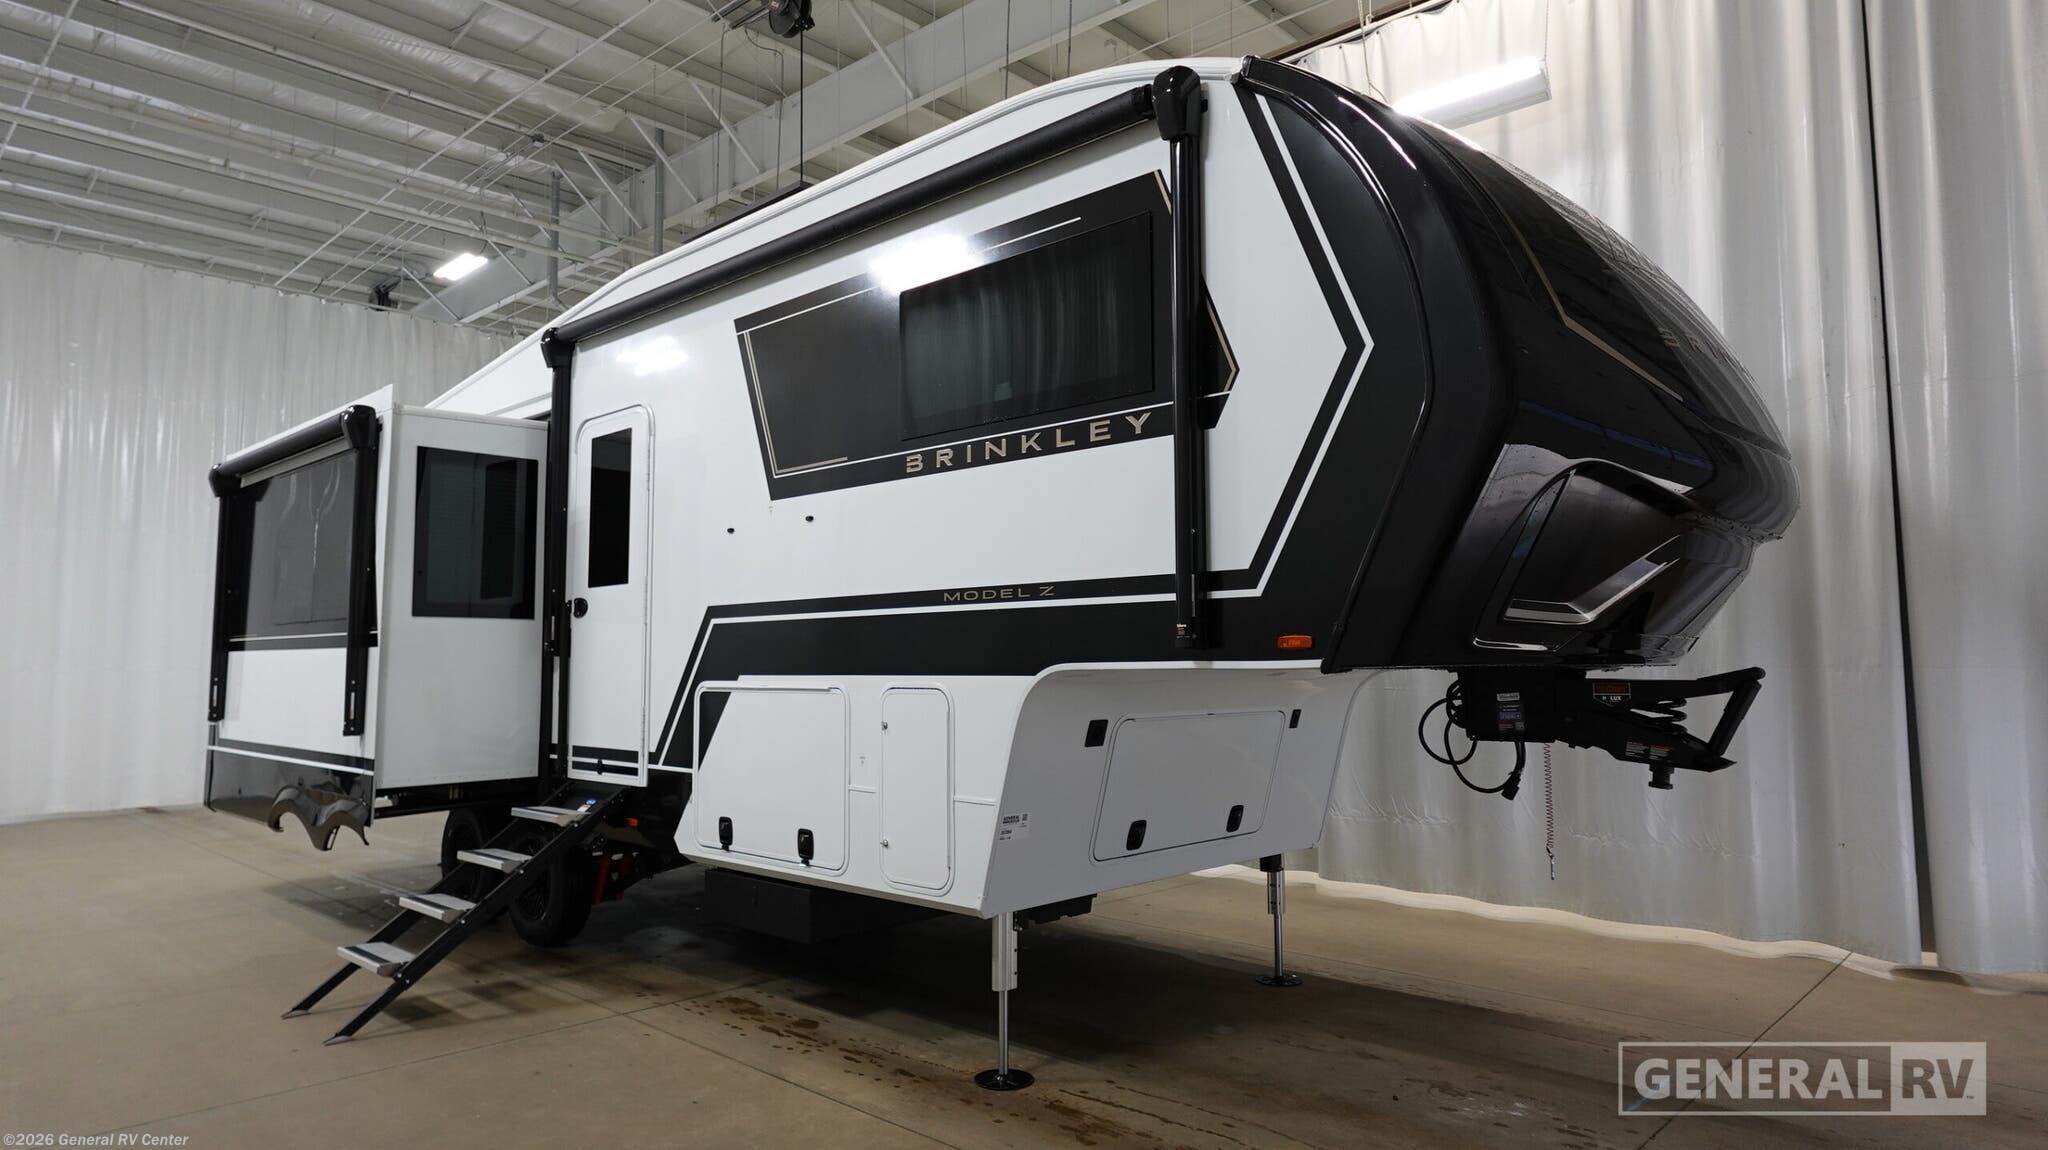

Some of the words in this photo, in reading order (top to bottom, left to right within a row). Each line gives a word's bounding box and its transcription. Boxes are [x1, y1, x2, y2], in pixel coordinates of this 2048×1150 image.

[905, 411, 1152, 474] BRINKLEY
[943, 587, 1031, 603] MODEL
[1039, 585, 1056, 597] Z
